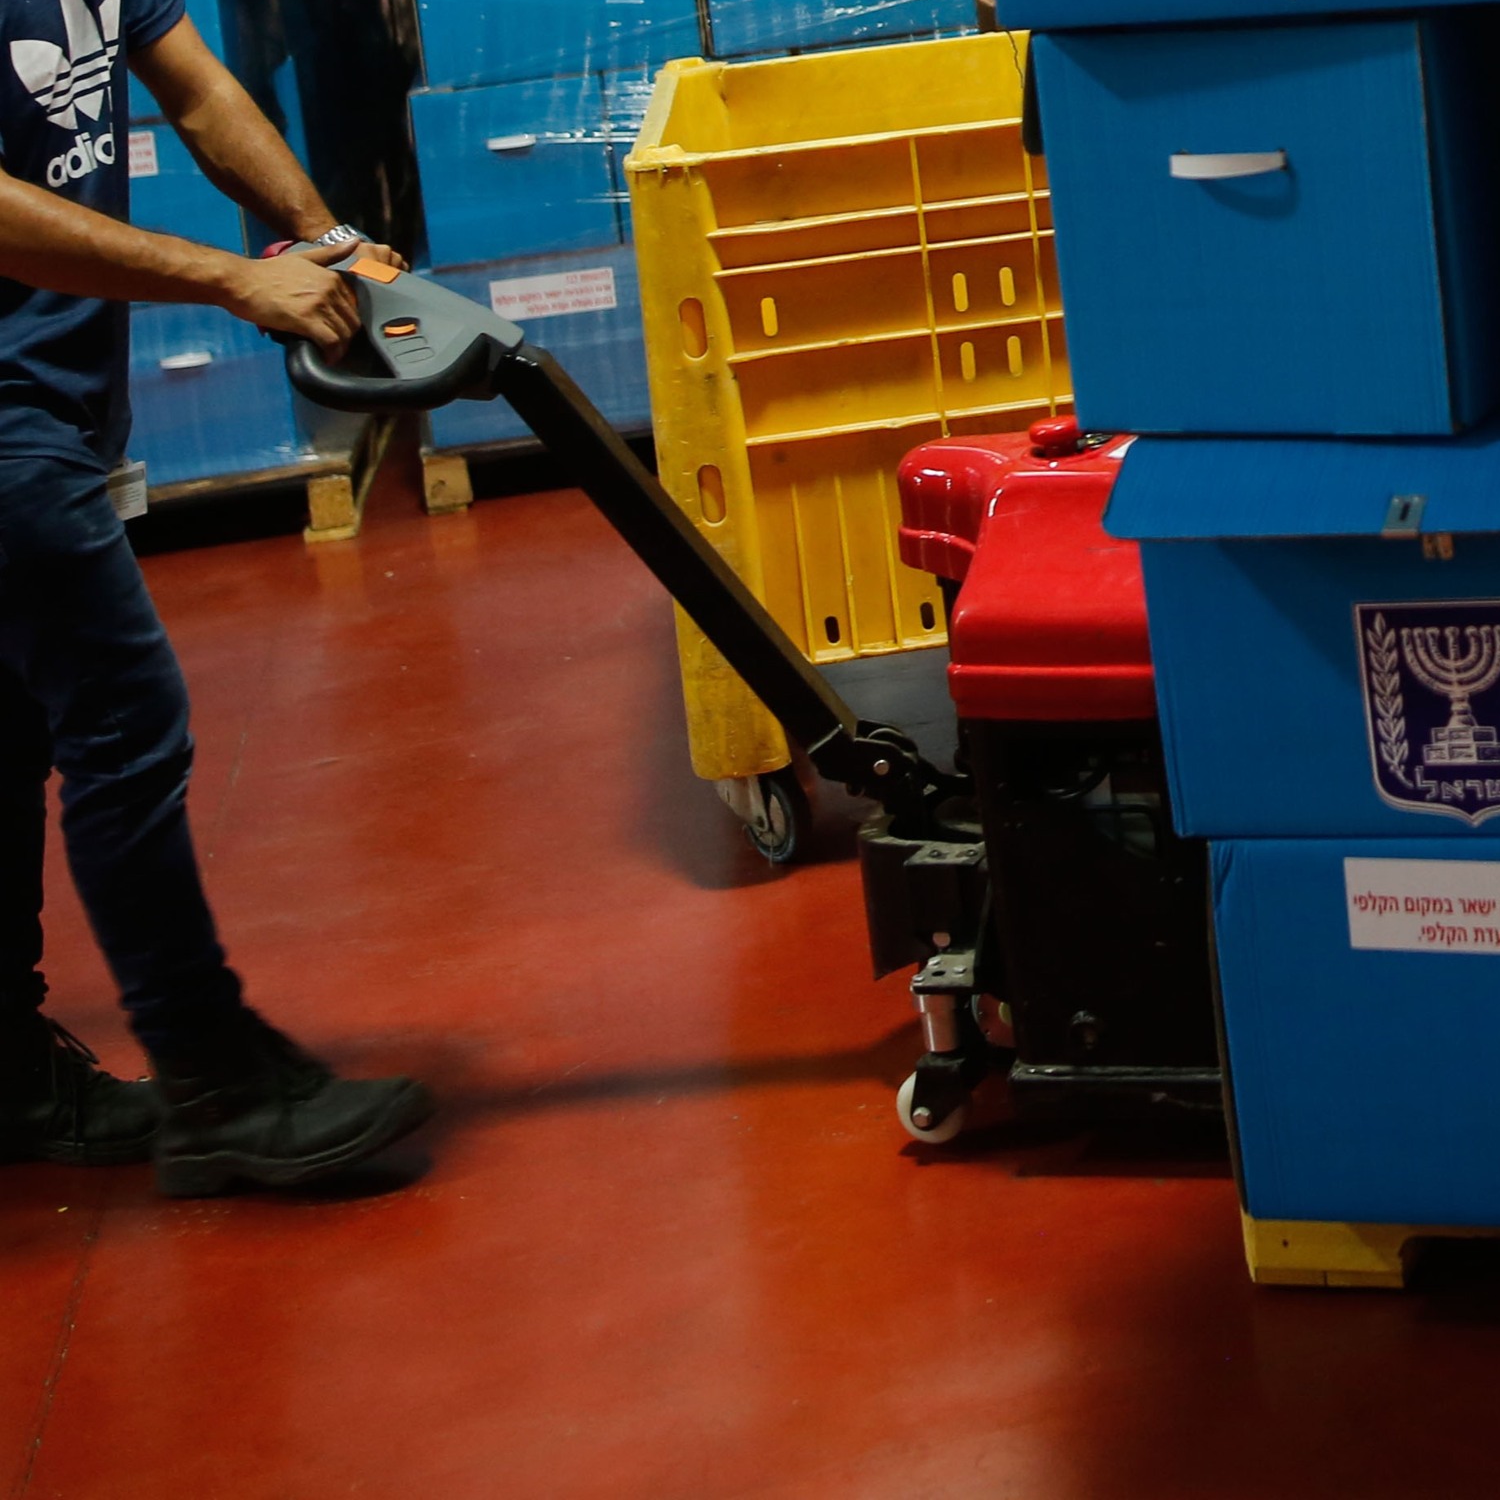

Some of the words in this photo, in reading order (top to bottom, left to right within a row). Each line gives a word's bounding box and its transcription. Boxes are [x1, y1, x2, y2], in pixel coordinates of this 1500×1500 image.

[1353, 891, 1399, 915] הקלפי
[1405, 897, 1454, 916] במקום
[1458, 898, 1496, 915] ישאר
